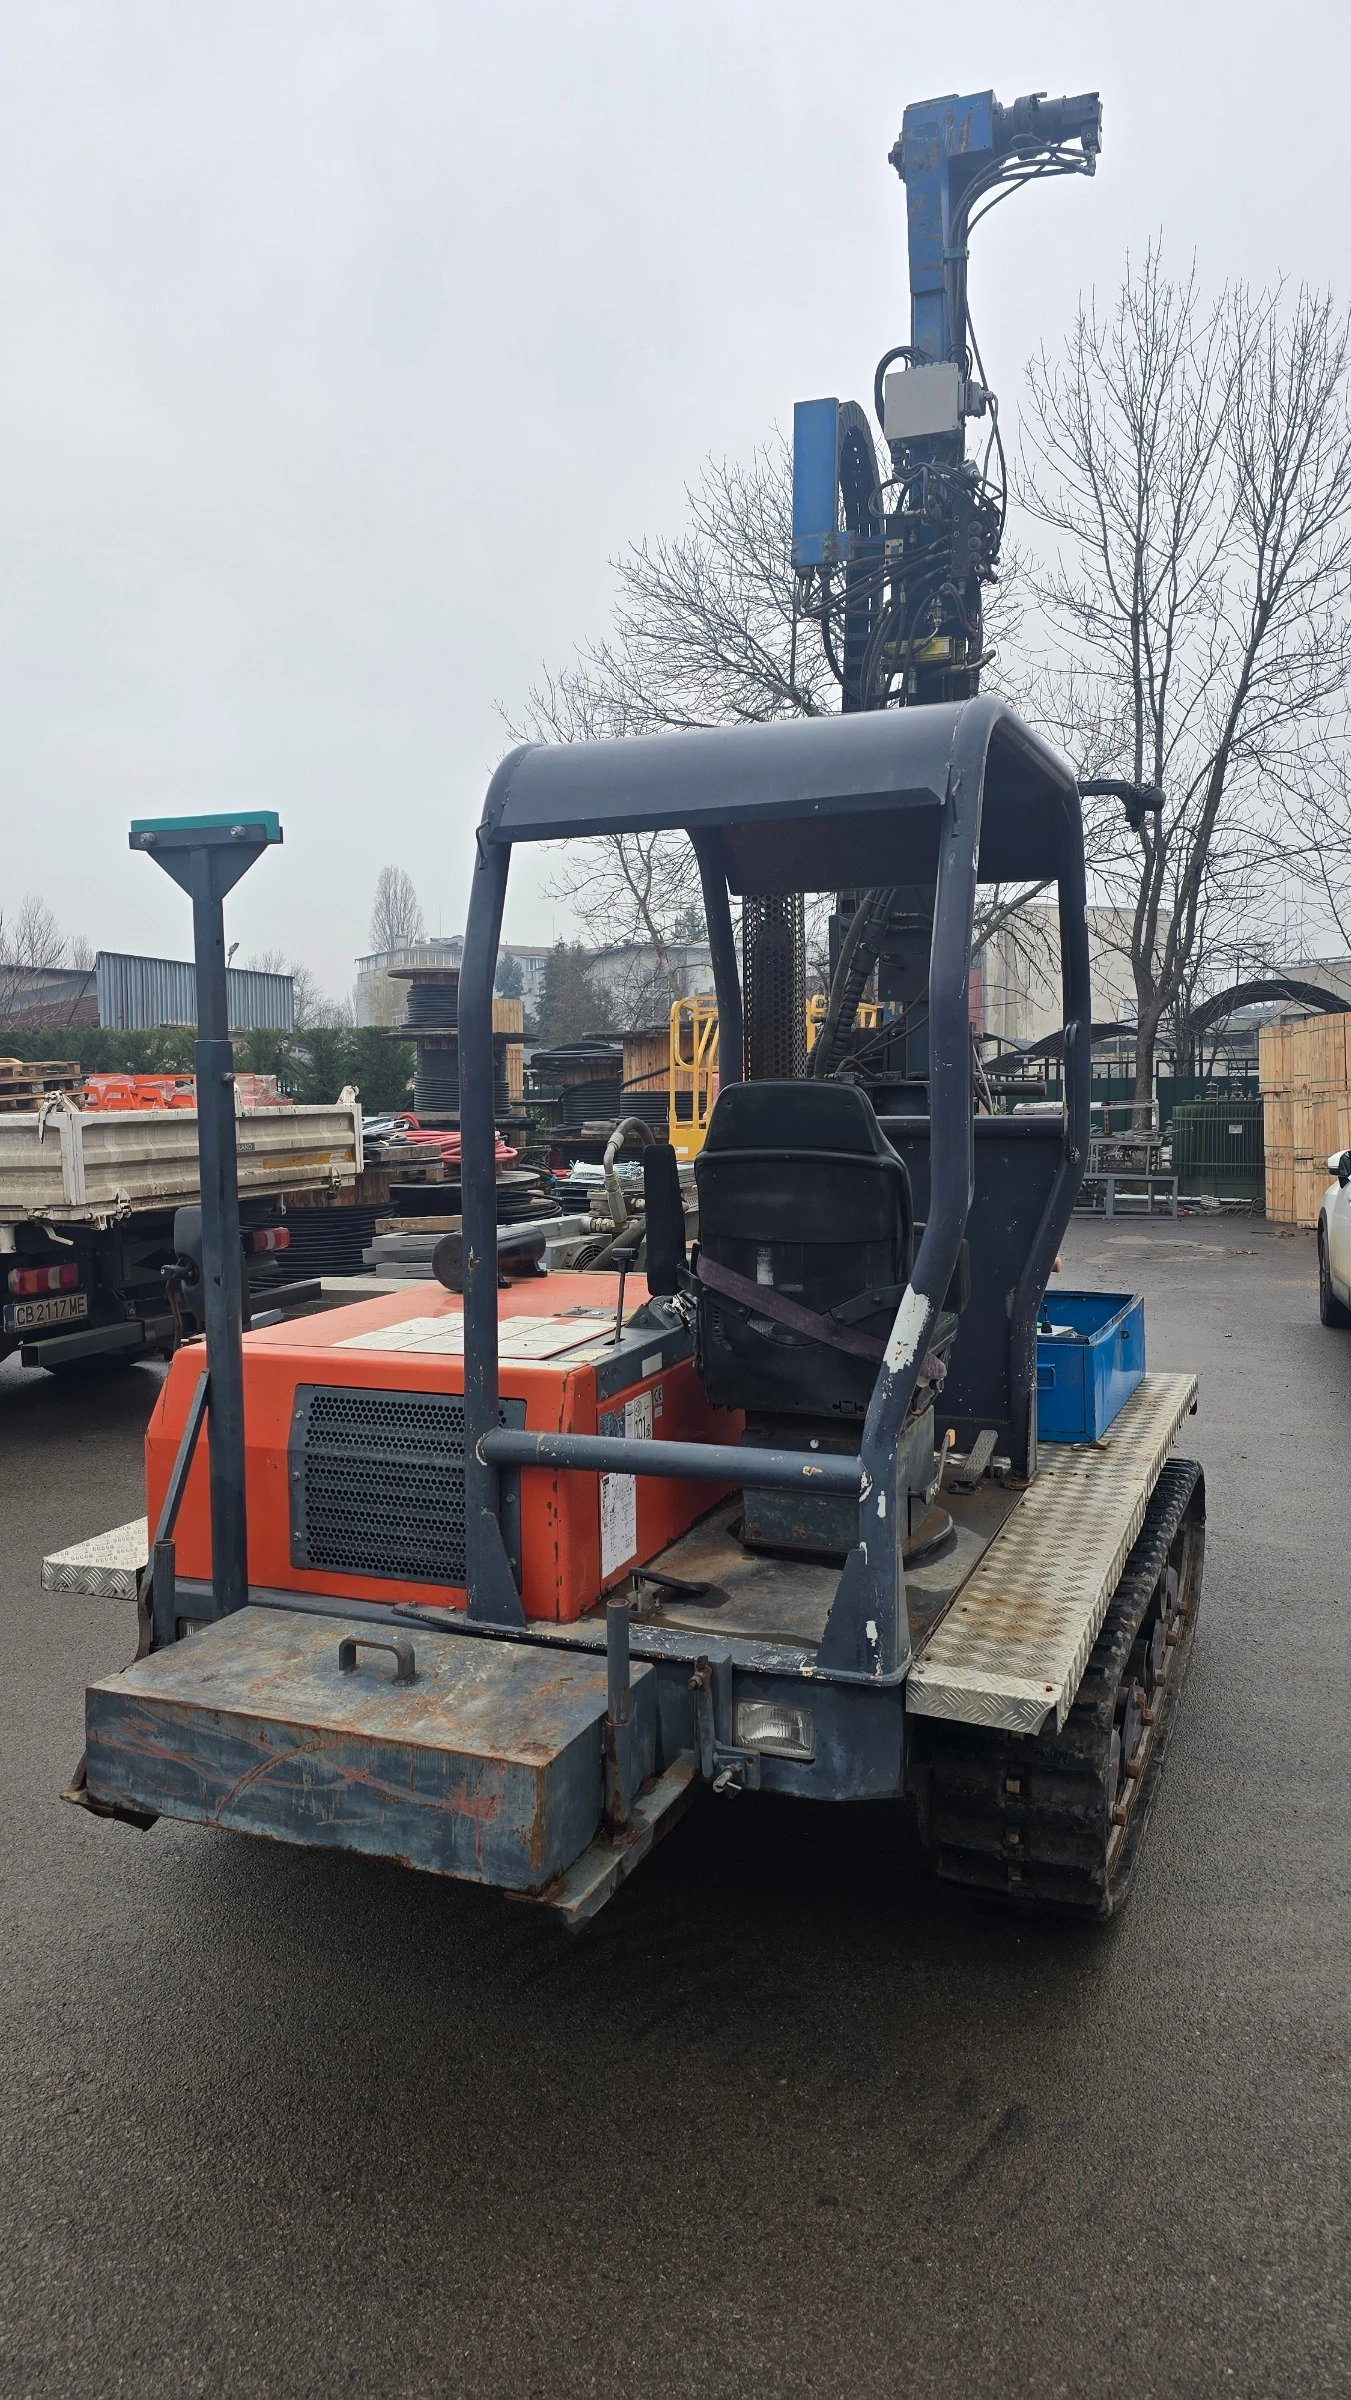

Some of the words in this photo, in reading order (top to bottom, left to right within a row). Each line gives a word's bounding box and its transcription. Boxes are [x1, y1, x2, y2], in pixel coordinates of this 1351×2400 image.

[16, 1305, 34, 1325] CB
[36, 1300, 67, 1321] 2117
[69, 1296, 86, 1315] ME
